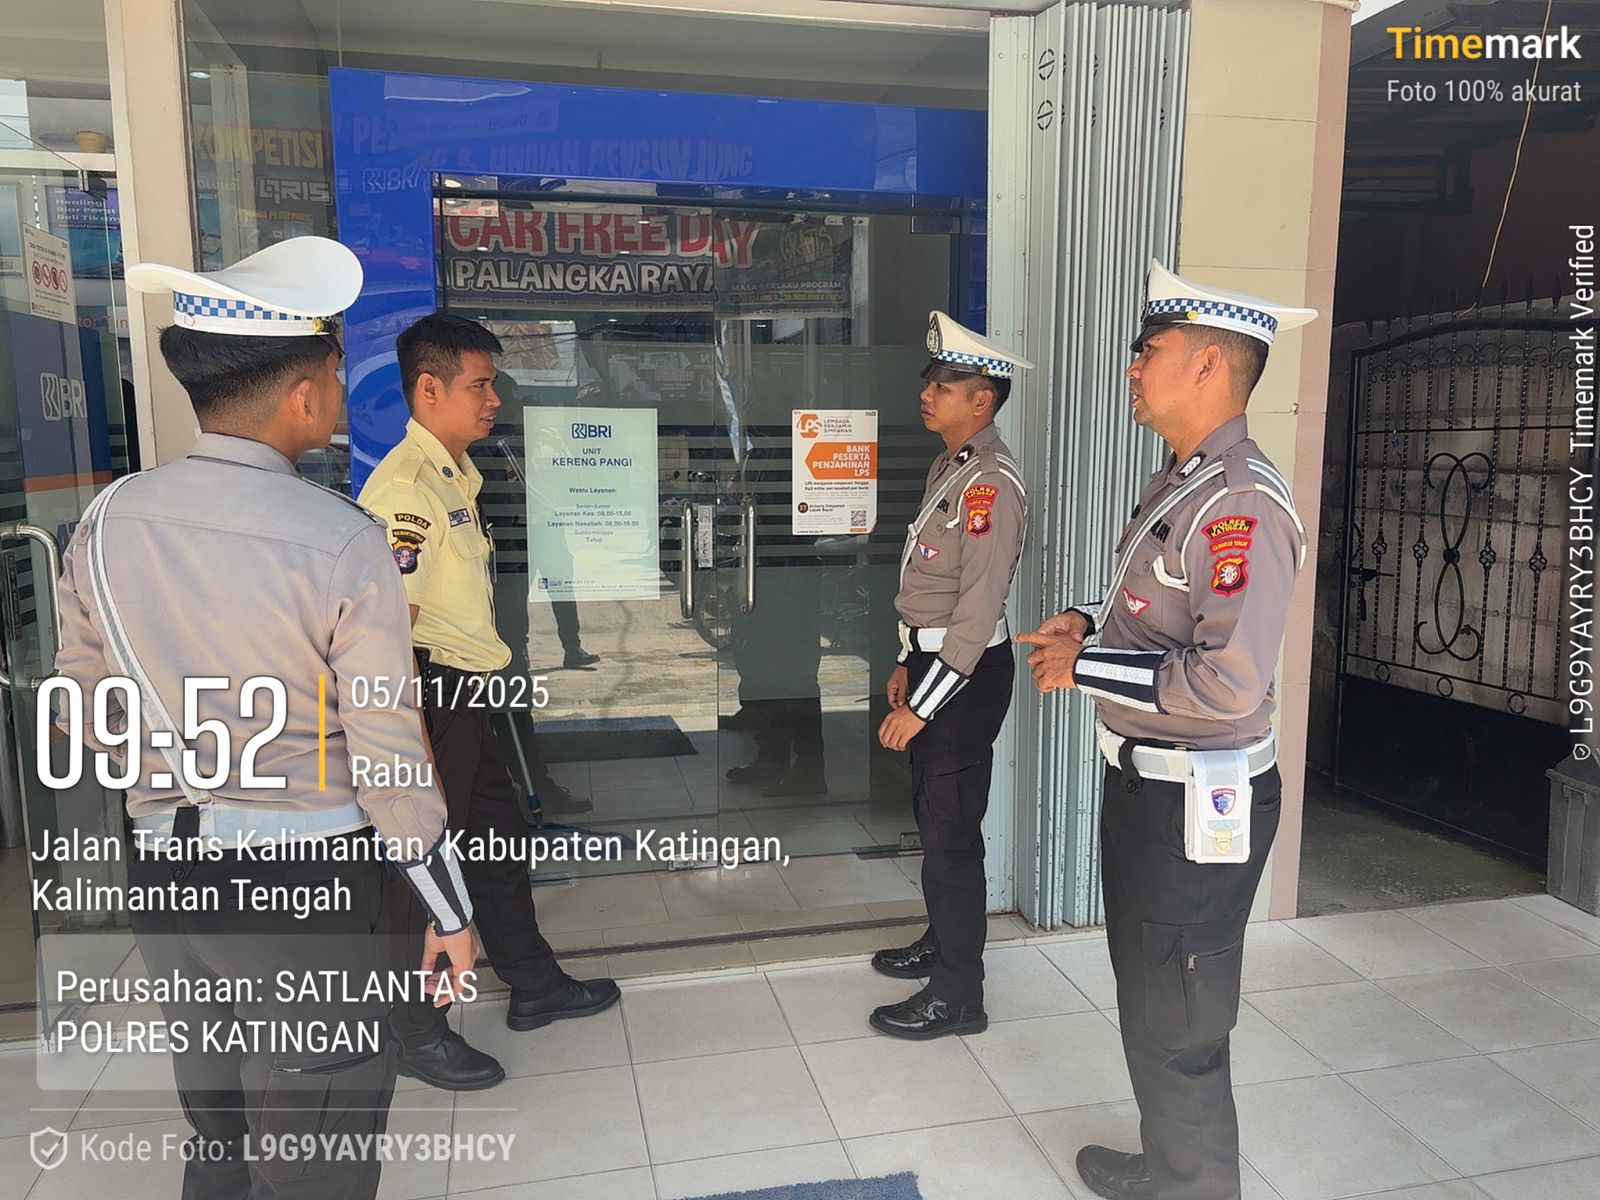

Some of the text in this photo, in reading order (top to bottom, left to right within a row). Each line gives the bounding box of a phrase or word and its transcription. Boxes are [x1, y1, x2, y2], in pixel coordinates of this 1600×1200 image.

[193, 127, 324, 169] KOMPETISI
[258, 177, 330, 205] QRIS
[449, 209, 760, 267] CAR FREE DAY
[456, 261, 634, 292] PALANGKA
[800, 281, 841, 290] PROGRAM
[588, 425, 611, 438] BRI
[846, 445, 870, 453] BANK
[552, 458, 632, 467] KERENG PANGI
[813, 461, 870, 469] PENJAMINAN
[854, 469, 870, 477] LPS
[397, 514, 428, 529] POLDA
